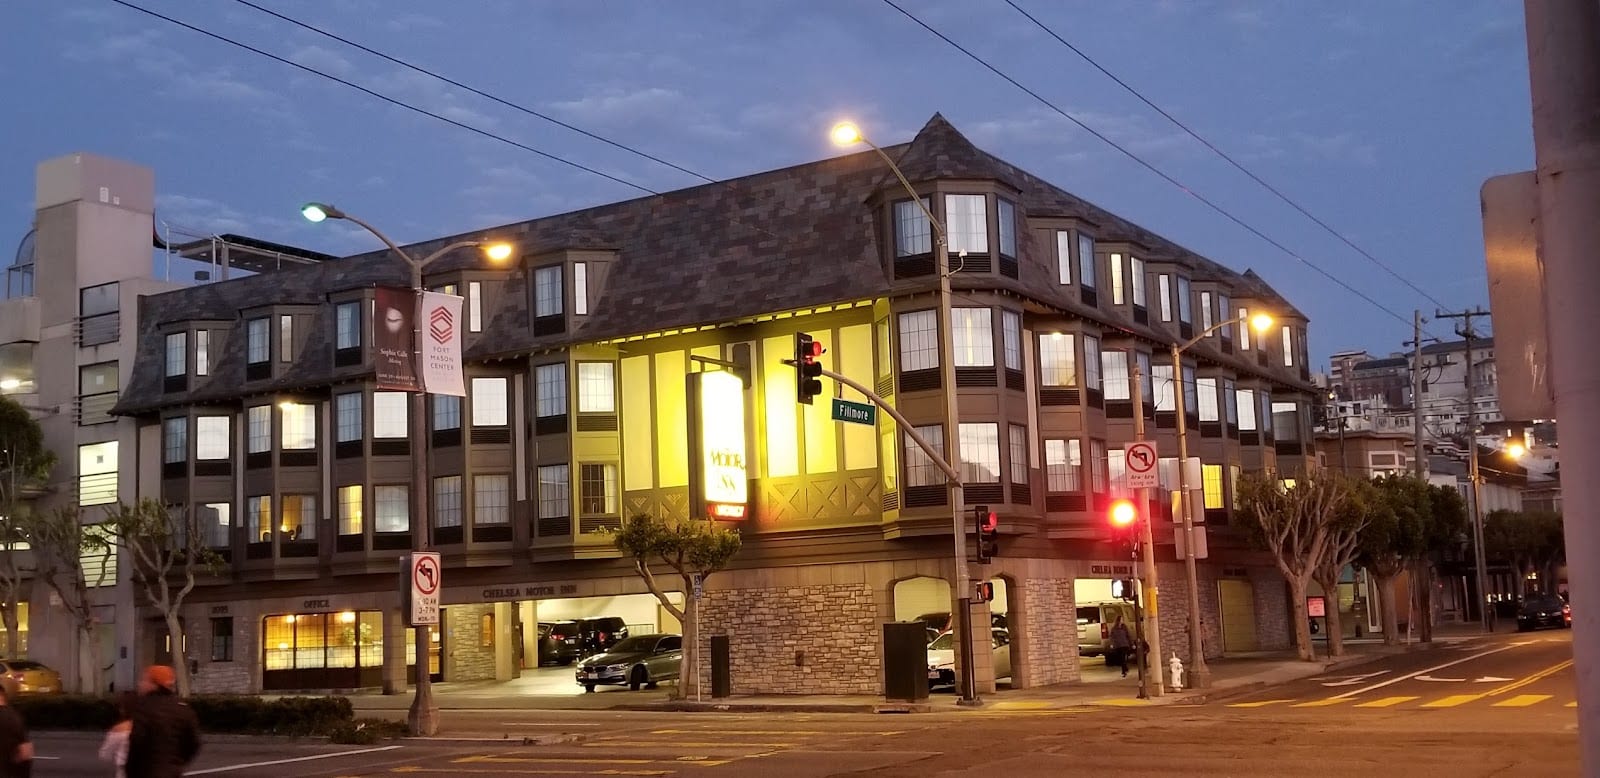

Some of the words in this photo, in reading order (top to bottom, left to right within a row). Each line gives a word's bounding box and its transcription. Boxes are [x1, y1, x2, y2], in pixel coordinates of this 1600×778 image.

[433, 346, 450, 354] FORT
[430, 354, 453, 362] MASON
[840, 404, 869, 421] Fillmore
[482, 587, 520, 599] CHELSEA
[526, 585, 554, 597] MOTOR
[560, 584, 577, 594] INN
[303, 600, 330, 609] OFFICE
